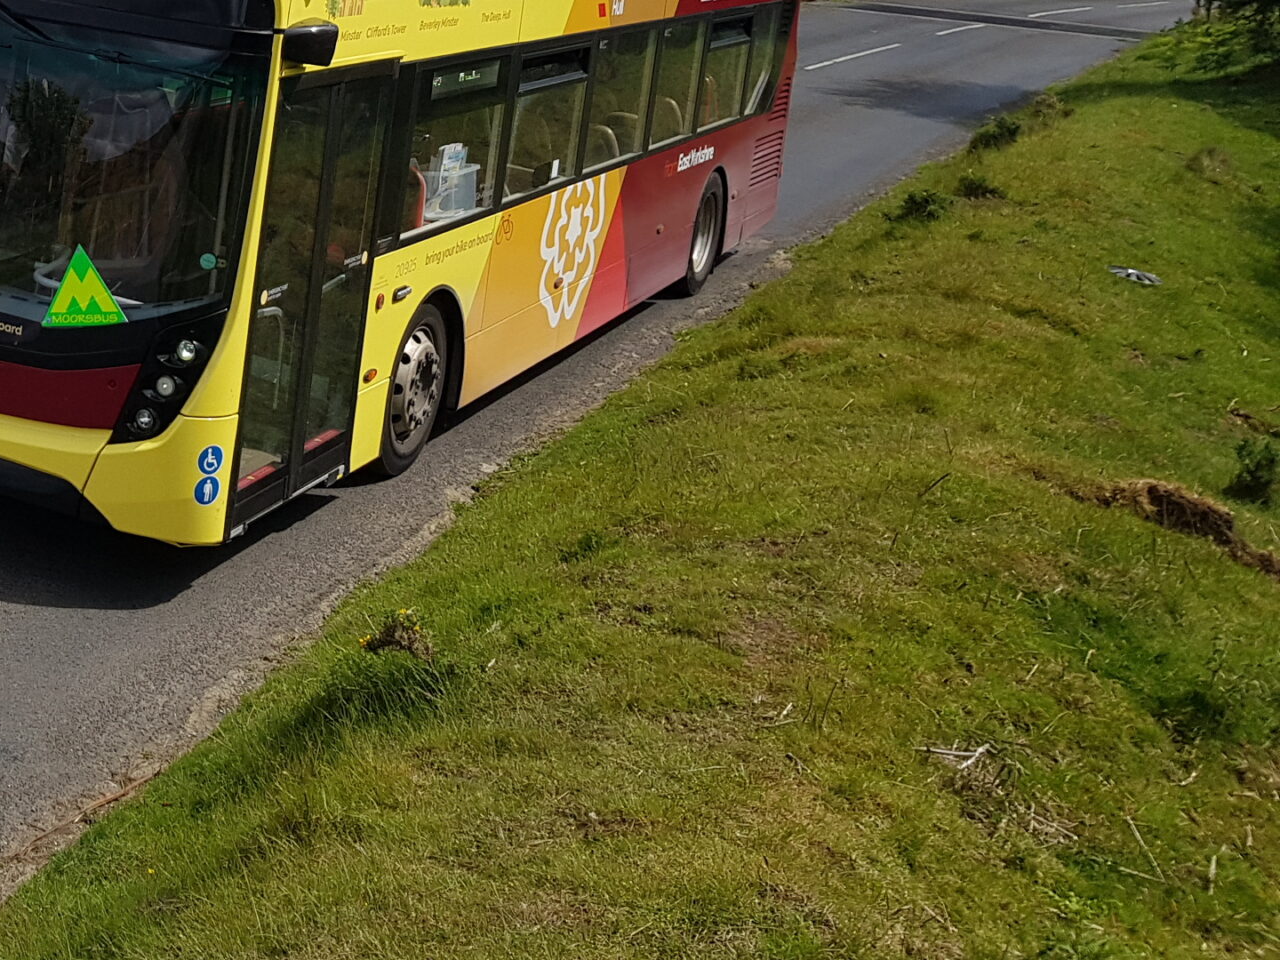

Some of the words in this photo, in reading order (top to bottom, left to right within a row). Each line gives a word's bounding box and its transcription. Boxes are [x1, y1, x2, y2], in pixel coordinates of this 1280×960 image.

[419, 18, 441, 32] Beverley
[677, 152, 691, 172] East
[425, 251, 442, 266] bring
[441, 246, 455, 263] your
[455, 240, 468, 254] bike
[468, 238, 477, 249] on
[476, 232, 493, 246] board
[52, 313, 118, 324] MOORSBUS
